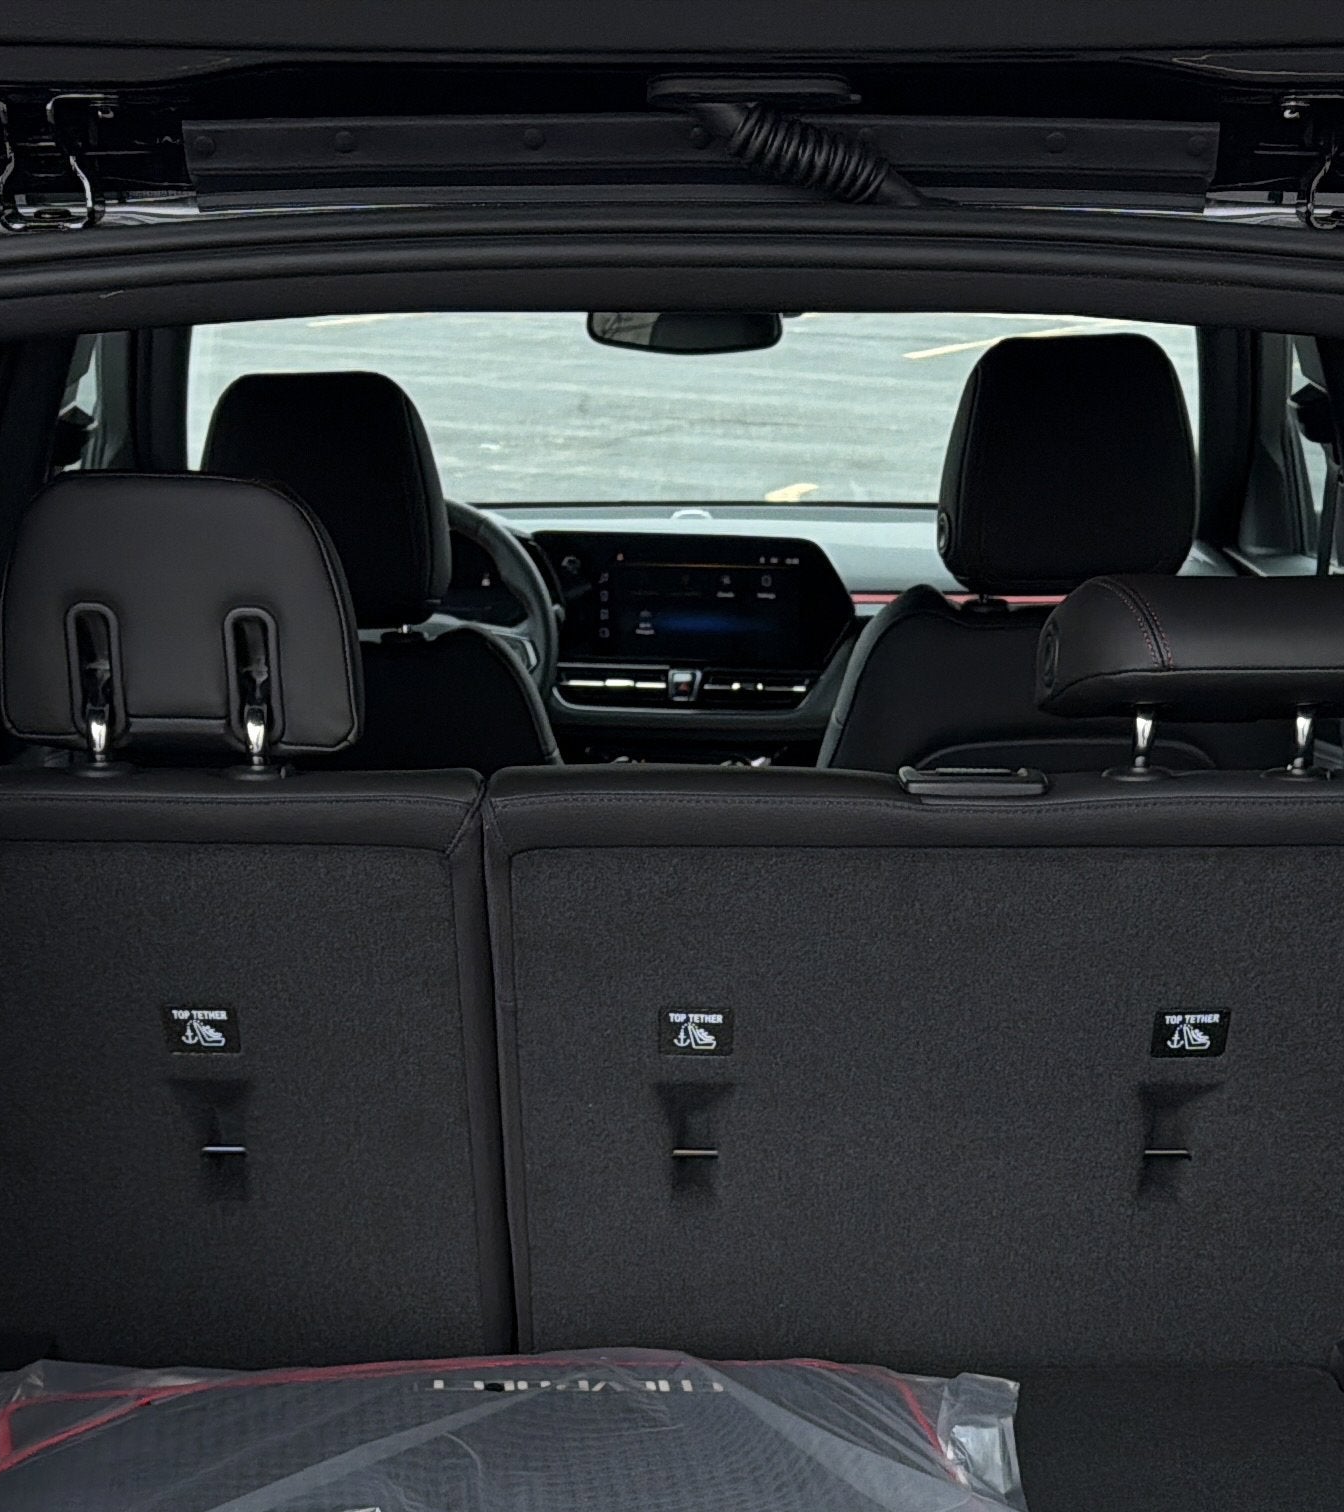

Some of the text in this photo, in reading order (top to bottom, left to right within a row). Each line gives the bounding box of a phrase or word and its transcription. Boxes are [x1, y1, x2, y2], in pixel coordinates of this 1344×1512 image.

[171, 1010, 228, 1020] TOP TETHER
[669, 1013, 723, 1023] TOP TETHER
[1165, 1014, 1220, 1024] TOP TETHER
